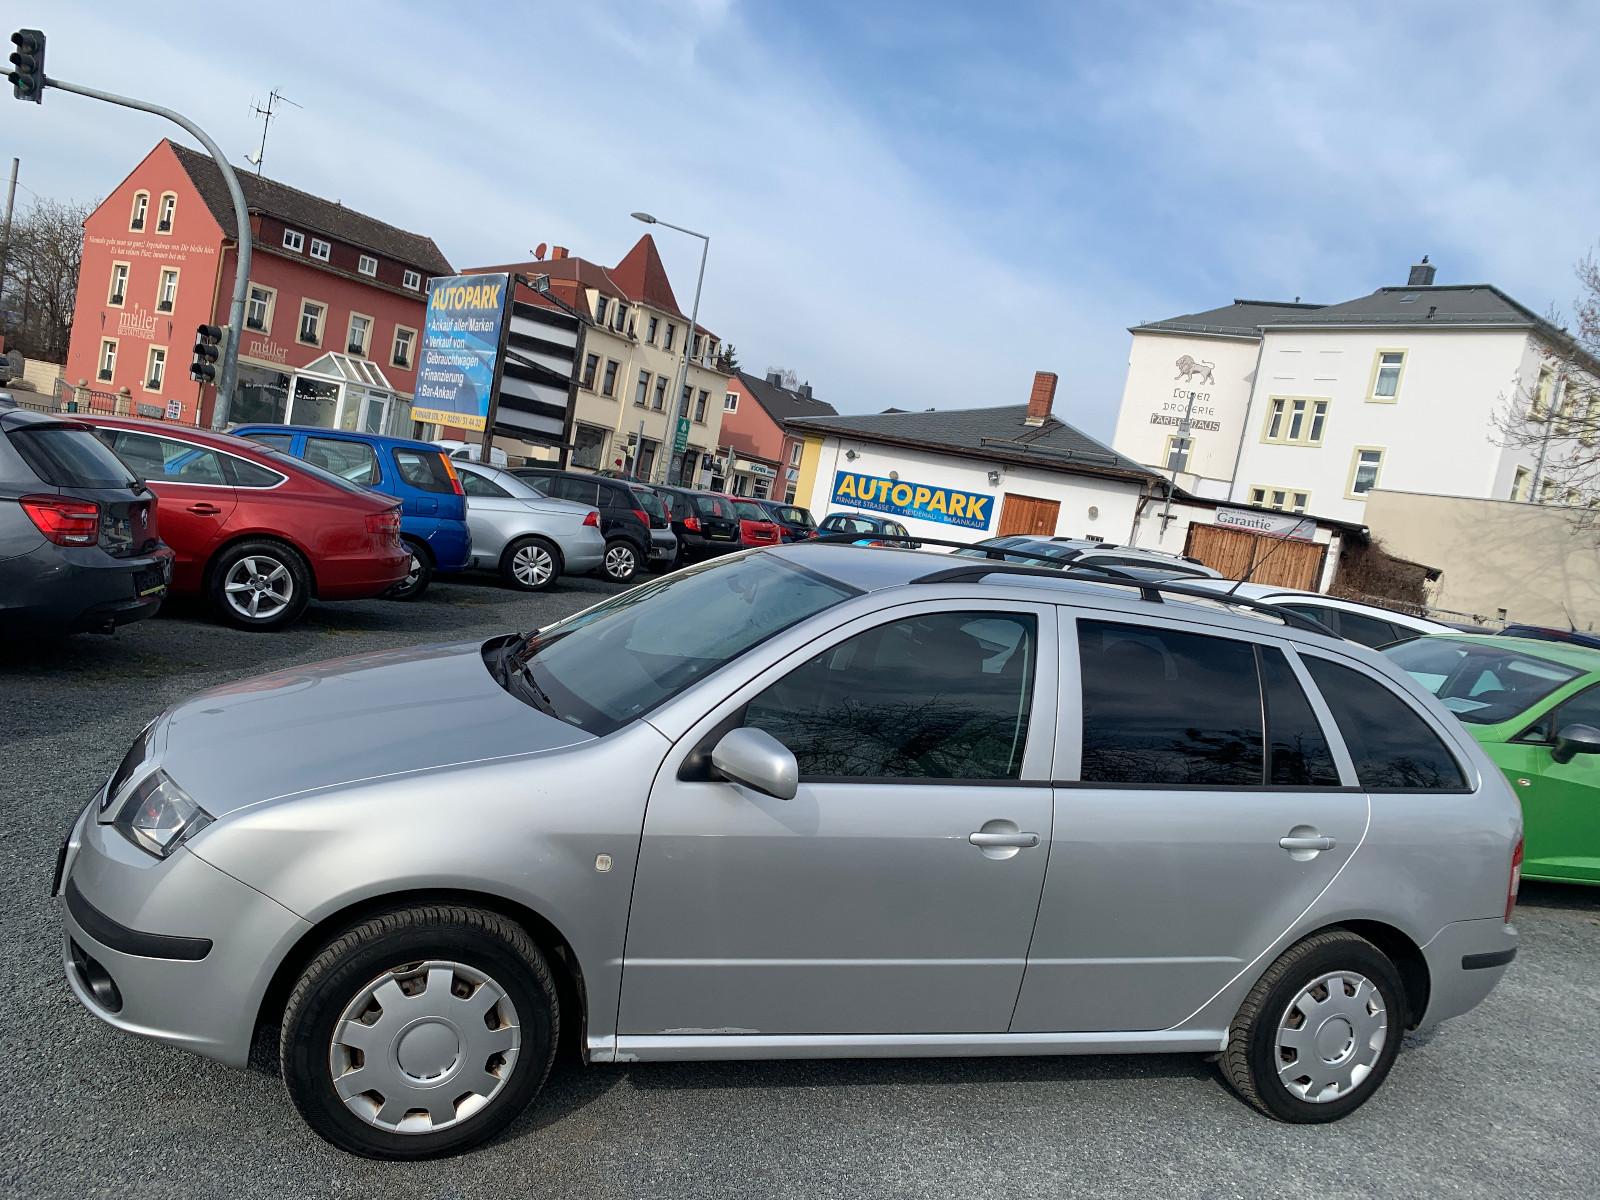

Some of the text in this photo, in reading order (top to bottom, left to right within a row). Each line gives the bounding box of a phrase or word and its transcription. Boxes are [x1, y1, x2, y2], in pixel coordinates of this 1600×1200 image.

[431, 284, 501, 310] AUTOPARK
[431, 318, 494, 332] Ankauf aller Marken
[429, 335, 465, 348] Verkauf von
[426, 351, 479, 369] Gebrauchtwagen
[424, 368, 464, 386] Finanzierung
[421, 384, 457, 400] Bar-Ankauf
[836, 474, 990, 521] AUTOPARK
[835, 496, 862, 508] PIRNAER
[862, 500, 889, 512] STRASSE
[943, 515, 985, 528] BARANKAUF
[1217, 512, 1271, 531] Garantie
